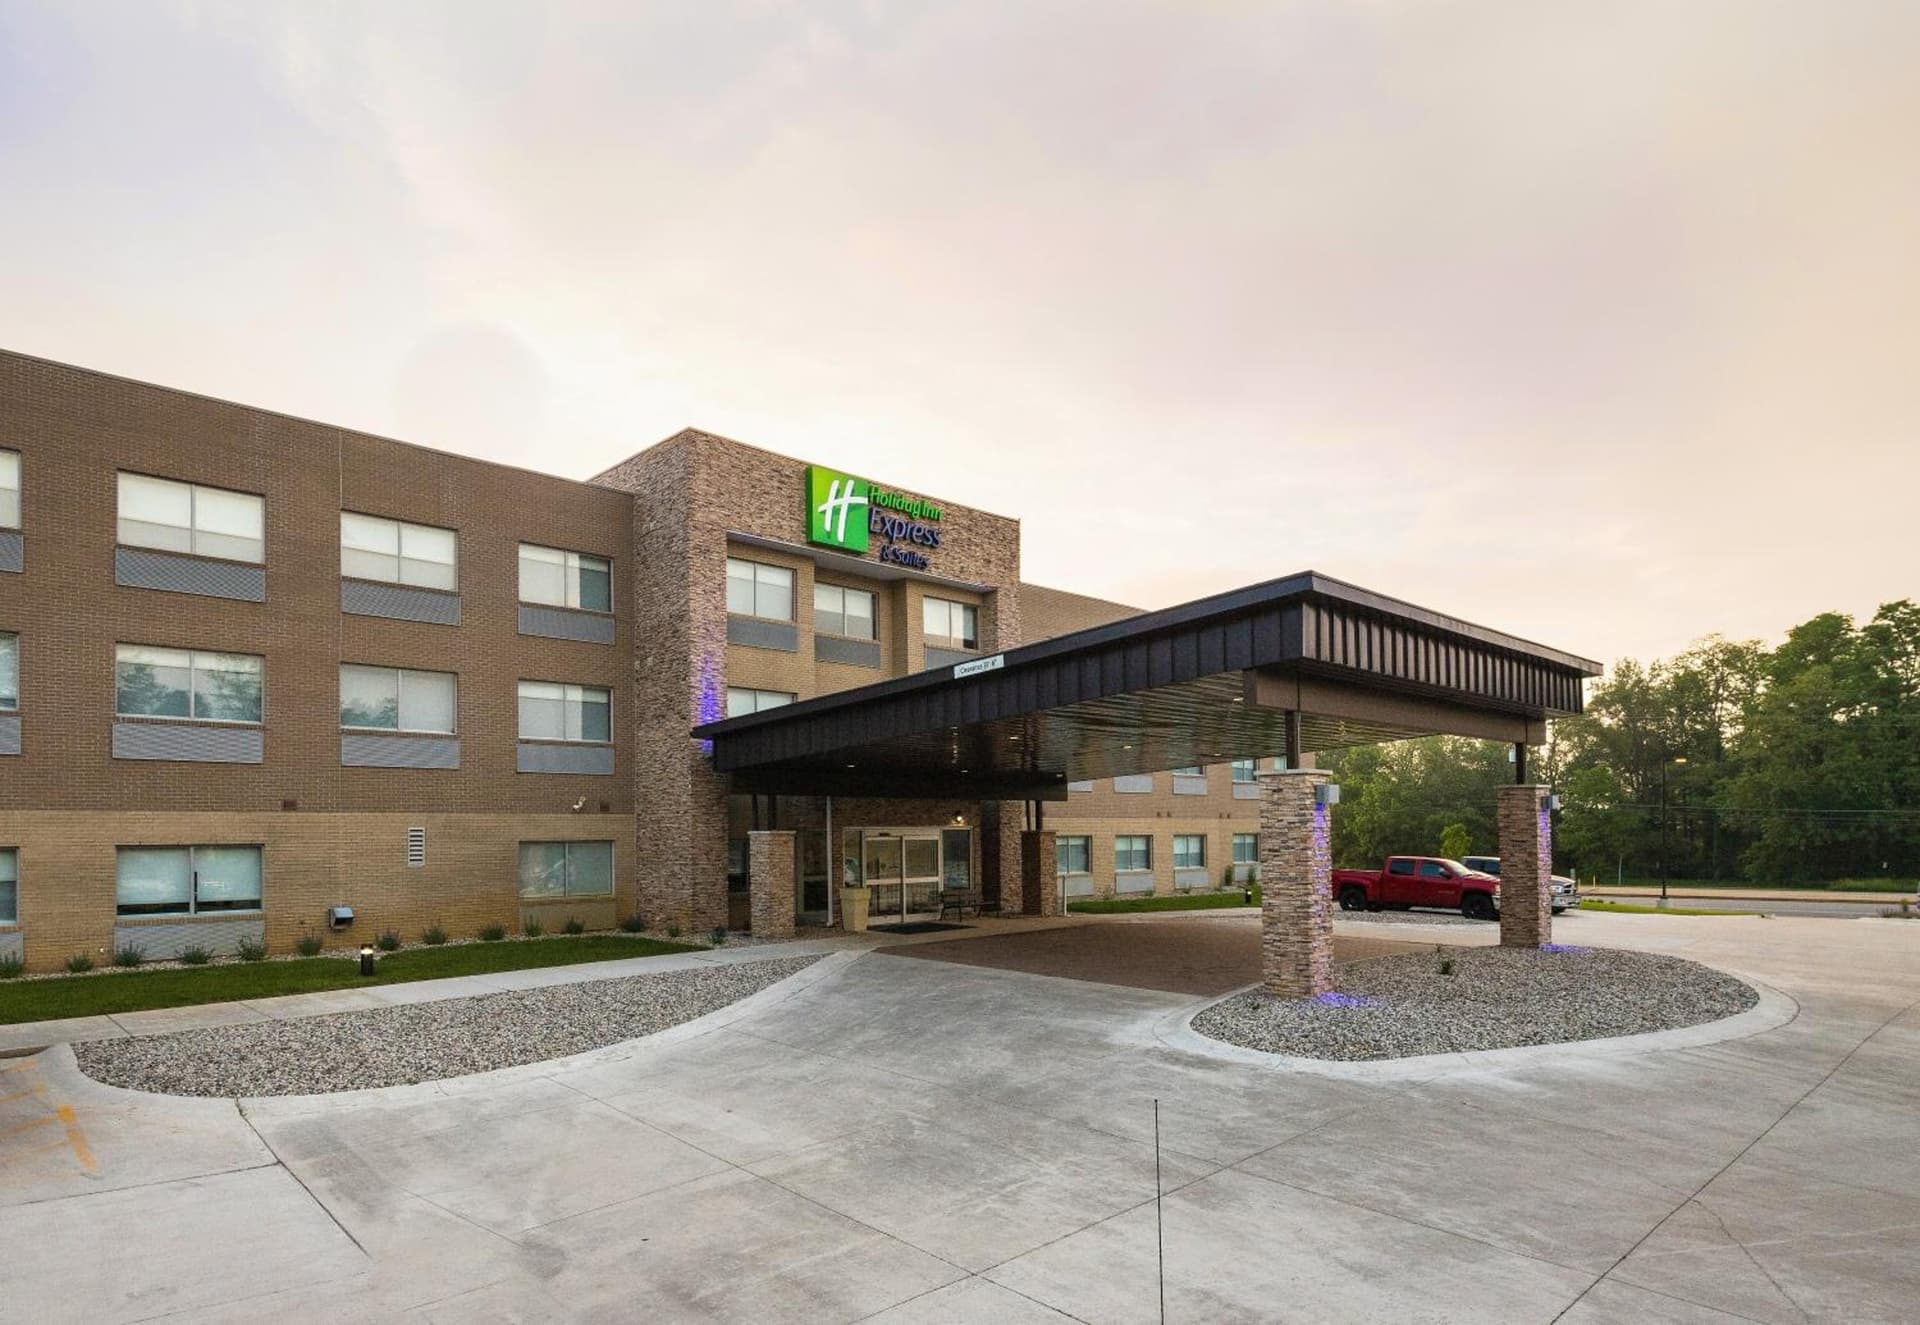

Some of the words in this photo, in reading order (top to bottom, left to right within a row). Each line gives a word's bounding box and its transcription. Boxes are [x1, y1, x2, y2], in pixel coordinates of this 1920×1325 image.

[869, 486, 921, 518] Holiday
[922, 501, 942, 520] Inn
[869, 506, 941, 548] Express
[881, 544, 892, 561] &
[893, 547, 930, 569] Suites
